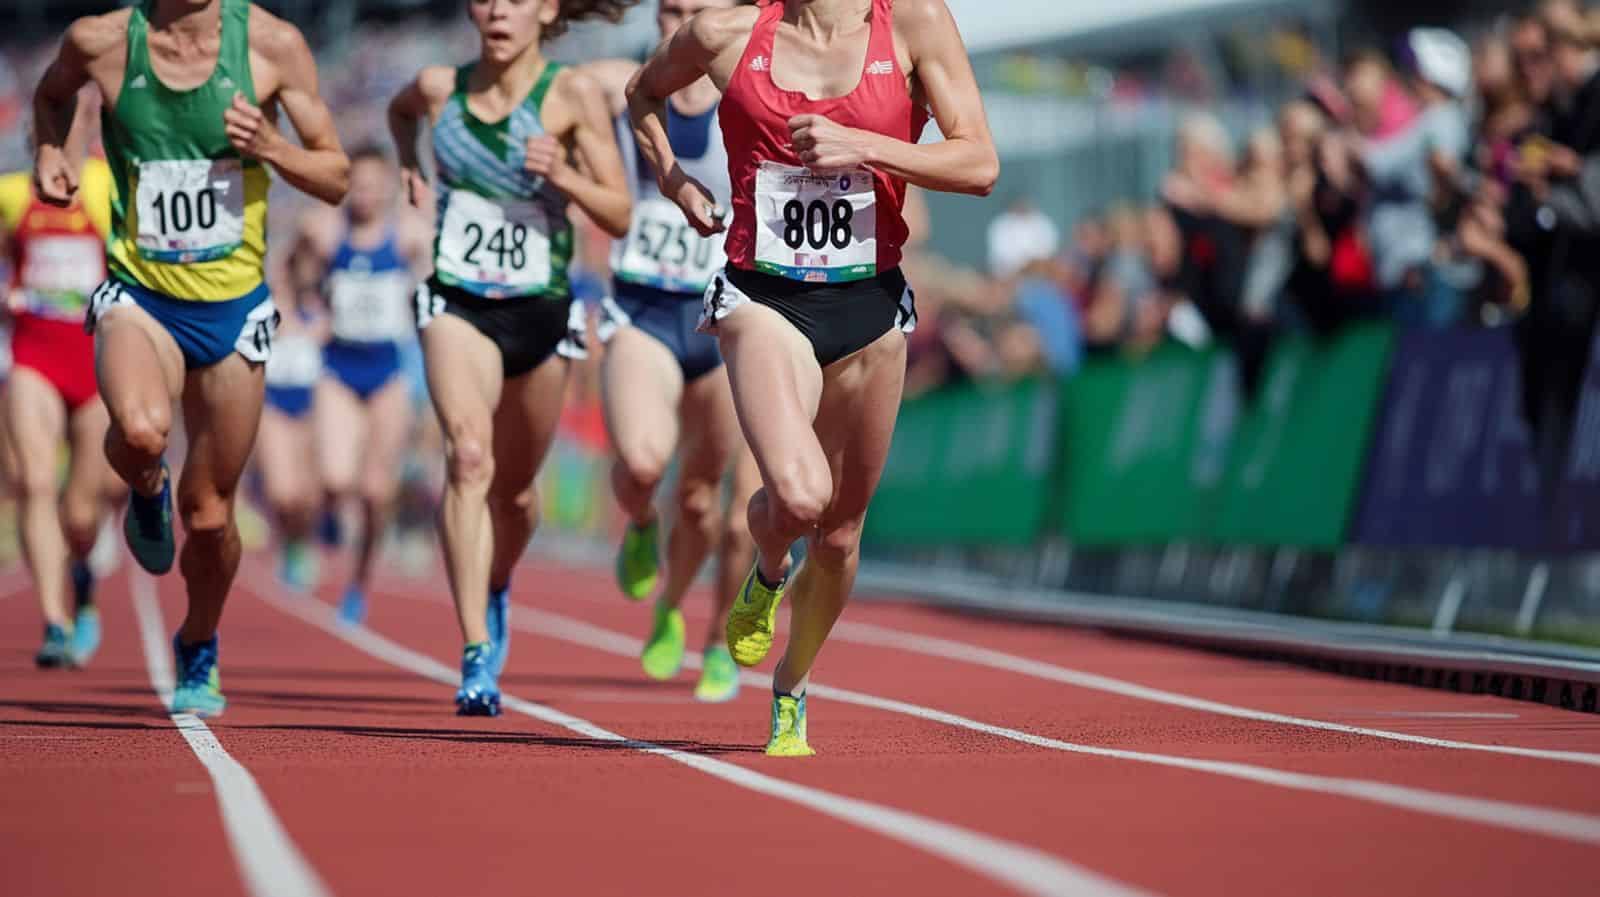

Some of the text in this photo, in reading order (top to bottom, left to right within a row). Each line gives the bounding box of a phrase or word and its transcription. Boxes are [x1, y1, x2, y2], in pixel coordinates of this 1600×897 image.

[152, 188, 216, 236] 100
[783, 198, 853, 250] 808
[463, 222, 527, 270] 248
